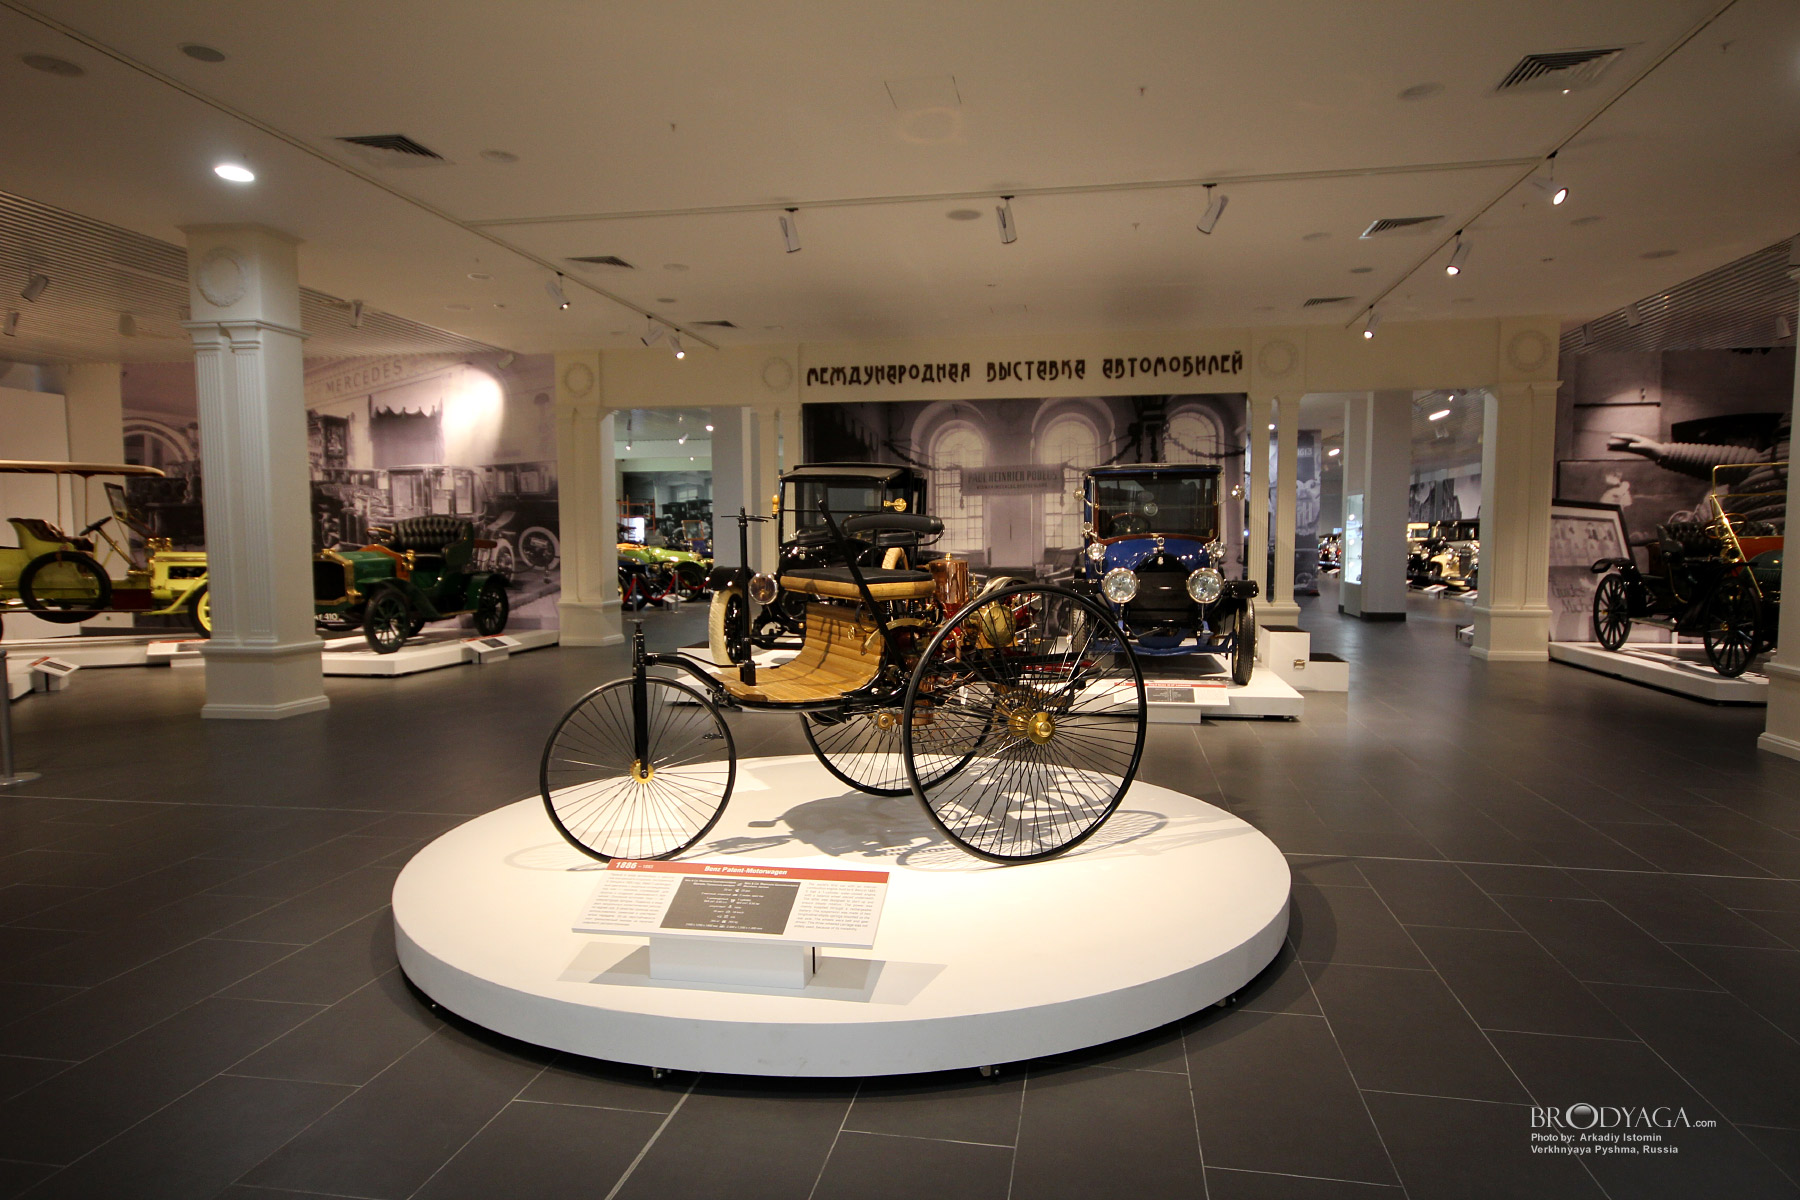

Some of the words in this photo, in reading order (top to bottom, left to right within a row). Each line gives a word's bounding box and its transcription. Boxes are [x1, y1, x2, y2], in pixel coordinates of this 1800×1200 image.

[806, 362, 971, 387] МЕЖДУНАРОДНАЯ
[986, 359, 1086, 382] ВЫСТАВКА
[1101, 351, 1243, 379] АВТОМОБИЛЕЙ
[327, 361, 402, 392] MERCEDES
[988, 470, 1025, 483] HEINRICH
[615, 861, 638, 869] 1886
[721, 866, 788, 876] Patent-Motorwagen
